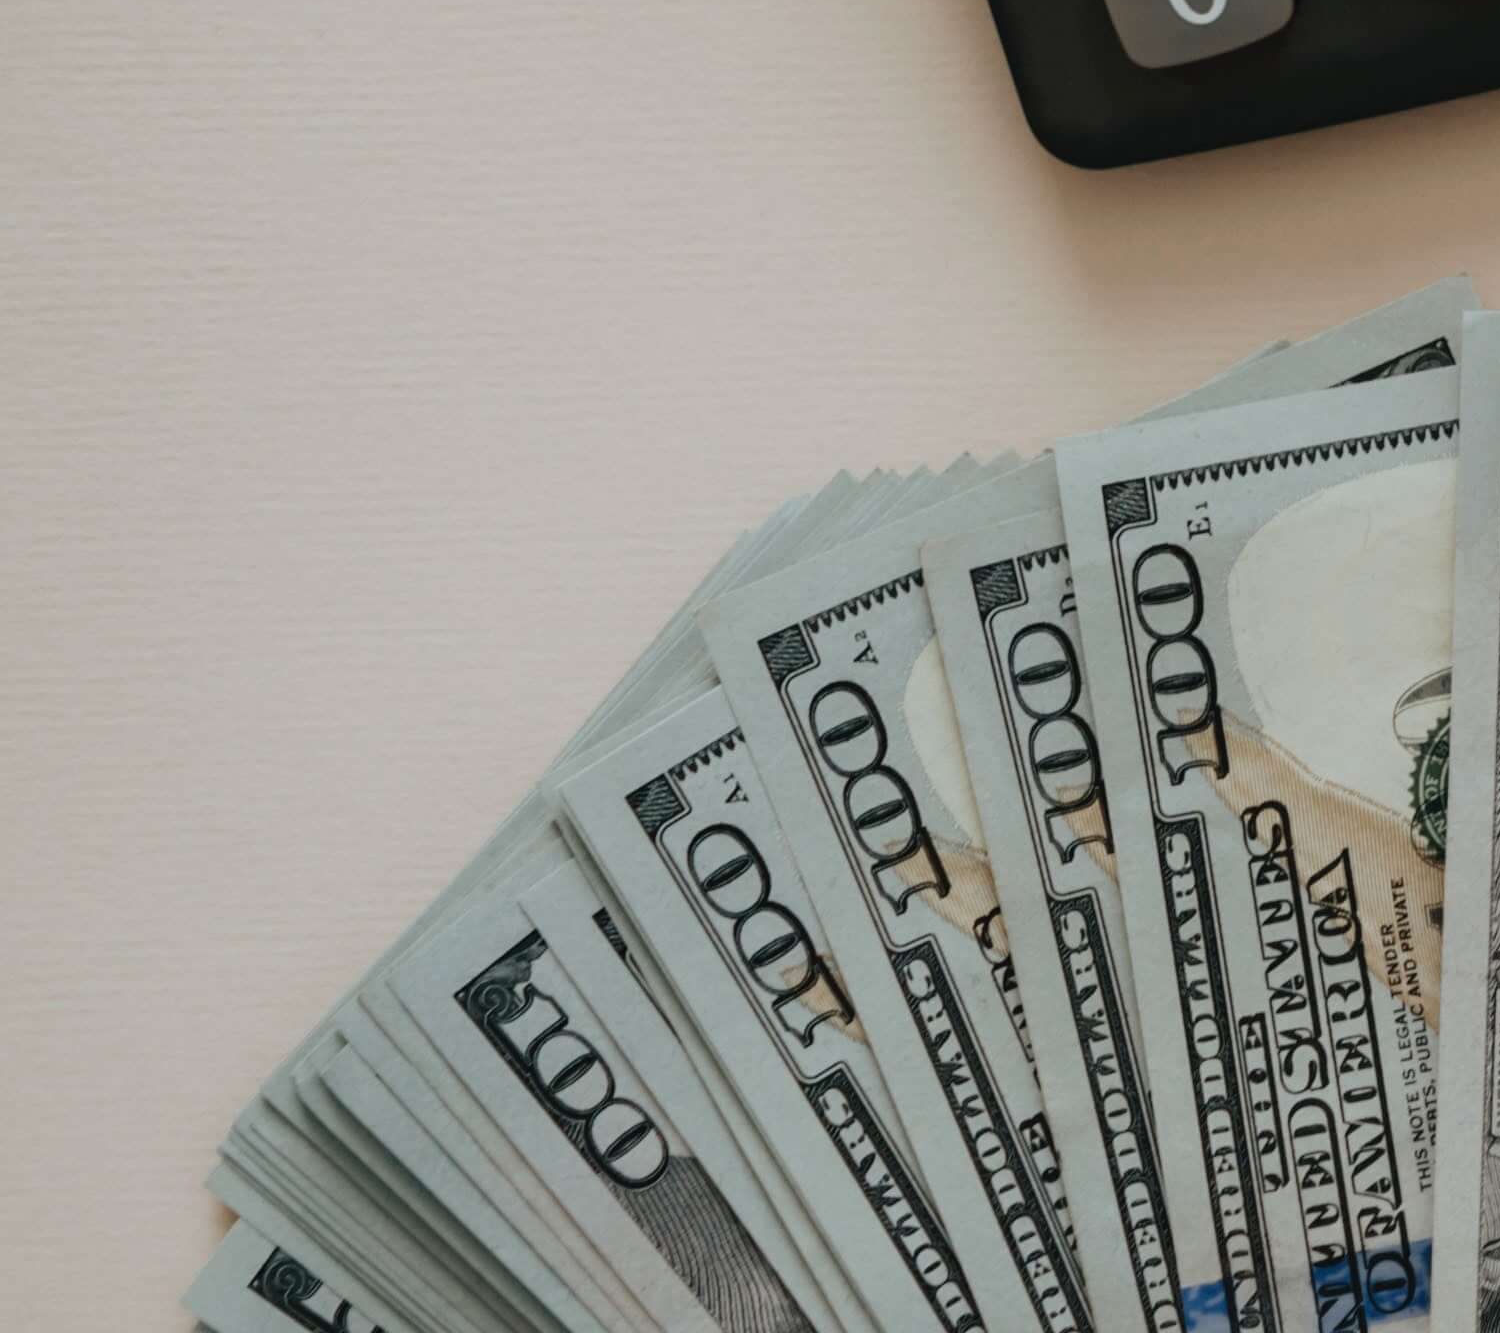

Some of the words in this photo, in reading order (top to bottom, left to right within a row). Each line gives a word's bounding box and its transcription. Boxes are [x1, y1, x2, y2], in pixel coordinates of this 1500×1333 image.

[1131, 542, 1230, 787] 100
[808, 679, 951, 917] 100
[686, 823, 856, 1049] 100
[483, 984, 669, 1189] 100
